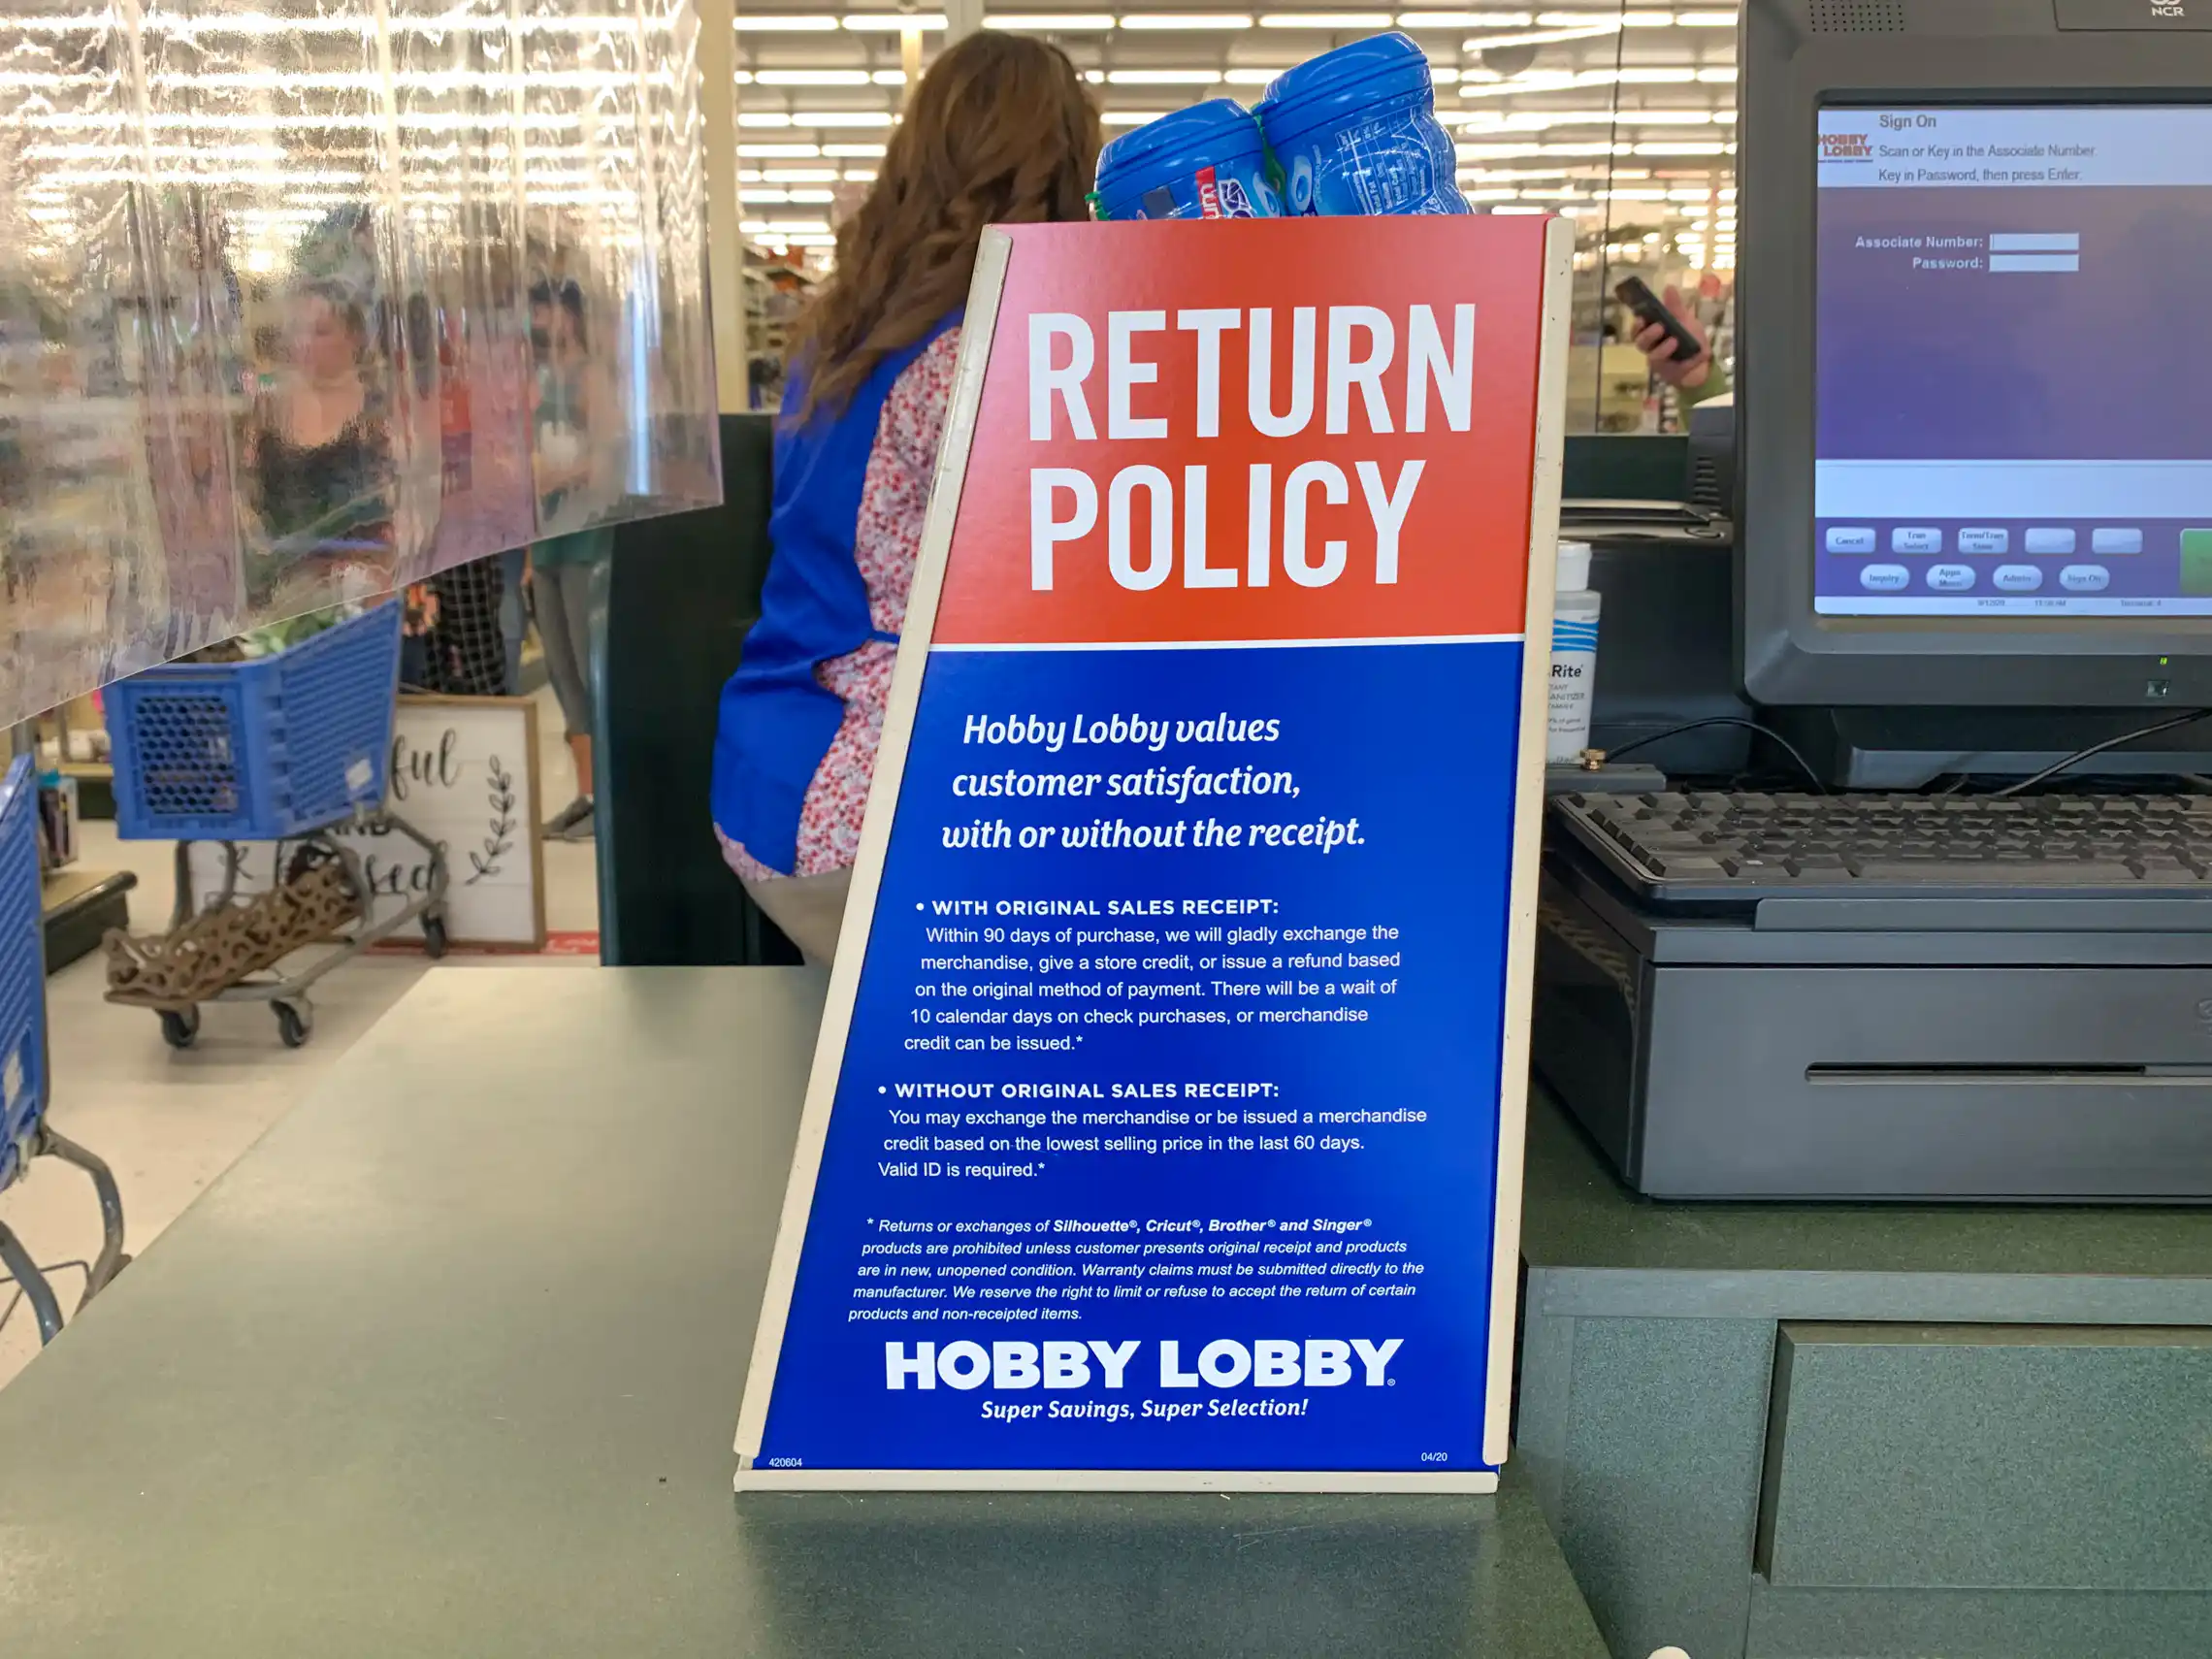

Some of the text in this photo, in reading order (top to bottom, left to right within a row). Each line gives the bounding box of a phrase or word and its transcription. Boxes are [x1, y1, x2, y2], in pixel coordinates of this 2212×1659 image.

[2151, 6, 2185, 16] NCR
[1879, 114, 1936, 131] Sign On
[1818, 134, 1868, 146] HOBBY
[1823, 146, 1872, 156] LOBBY
[1879, 146, 1909, 157] Scan
[1911, 148, 1925, 157] or
[1928, 146, 1950, 161] Key
[1953, 146, 1964, 157] in
[1967, 146, 1985, 157] the
[1988, 145, 2045, 157] Associate
[1878, 169, 1901, 183] Key
[1903, 169, 1914, 180] in
[1918, 168, 1979, 182] Password,
[1983, 169, 2008, 180] then
[2011, 171, 2044, 182] press
[1855, 235, 1983, 248] Associate Number:
[1913, 257, 1983, 269] Password:
[1027, 303, 1477, 442] RETURN
[1029, 459, 1428, 592] POLICY
[1835, 537, 1865, 545] Cancel
[1552, 665, 1582, 677] Rite
[962, 711, 1281, 753] Hobby Lobby values
[952, 764, 1300, 804] customer satisfaction,
[942, 816, 1365, 854] with or without the receipt.
[931, 898, 1279, 916] WITH ORIGINAL SALES RECEIPT:
[926, 925, 1399, 947] Within 90 days of purchase, we will gladly exchange the
[915, 978, 1398, 1000] on the original method of payment. There will be a wait of
[904, 1035, 951, 1051] credit
[955, 1038, 985, 1051] can
[991, 1035, 1011, 1051] be
[895, 1083, 1279, 1098] WITHOUT ORIGINAL SALES RECEIPT:
[889, 1107, 1427, 1128] You may exchange the merchandise or be issued a merchandise
[883, 1134, 1364, 1155] credit based on the lowest selling price in the last 60 days.
[877, 1161, 918, 1177] Valid
[924, 1161, 941, 1177] ID
[947, 1162, 960, 1177] is
[878, 1220, 933, 1232] Returns
[937, 1222, 953, 1232] or
[955, 1220, 1031, 1235] exchanges
[1035, 1220, 1051, 1232] of
[1279, 1219, 1309, 1232] and
[862, 1240, 1408, 1257] products are prohibited unless customer presents original receipt and products
[853, 1284, 1416, 1301] manufacturer. We reserve the right to limit or refuse to accept the return of certain
[848, 1307, 1082, 1322] products and non-receipted items.
[885, 1340, 1142, 1390] HOBBY
[981, 1398, 1309, 1423] Super Savings, Super Selection!
[768, 1458, 802, 1467] 420604
[1420, 1451, 1448, 1462] 04/20
